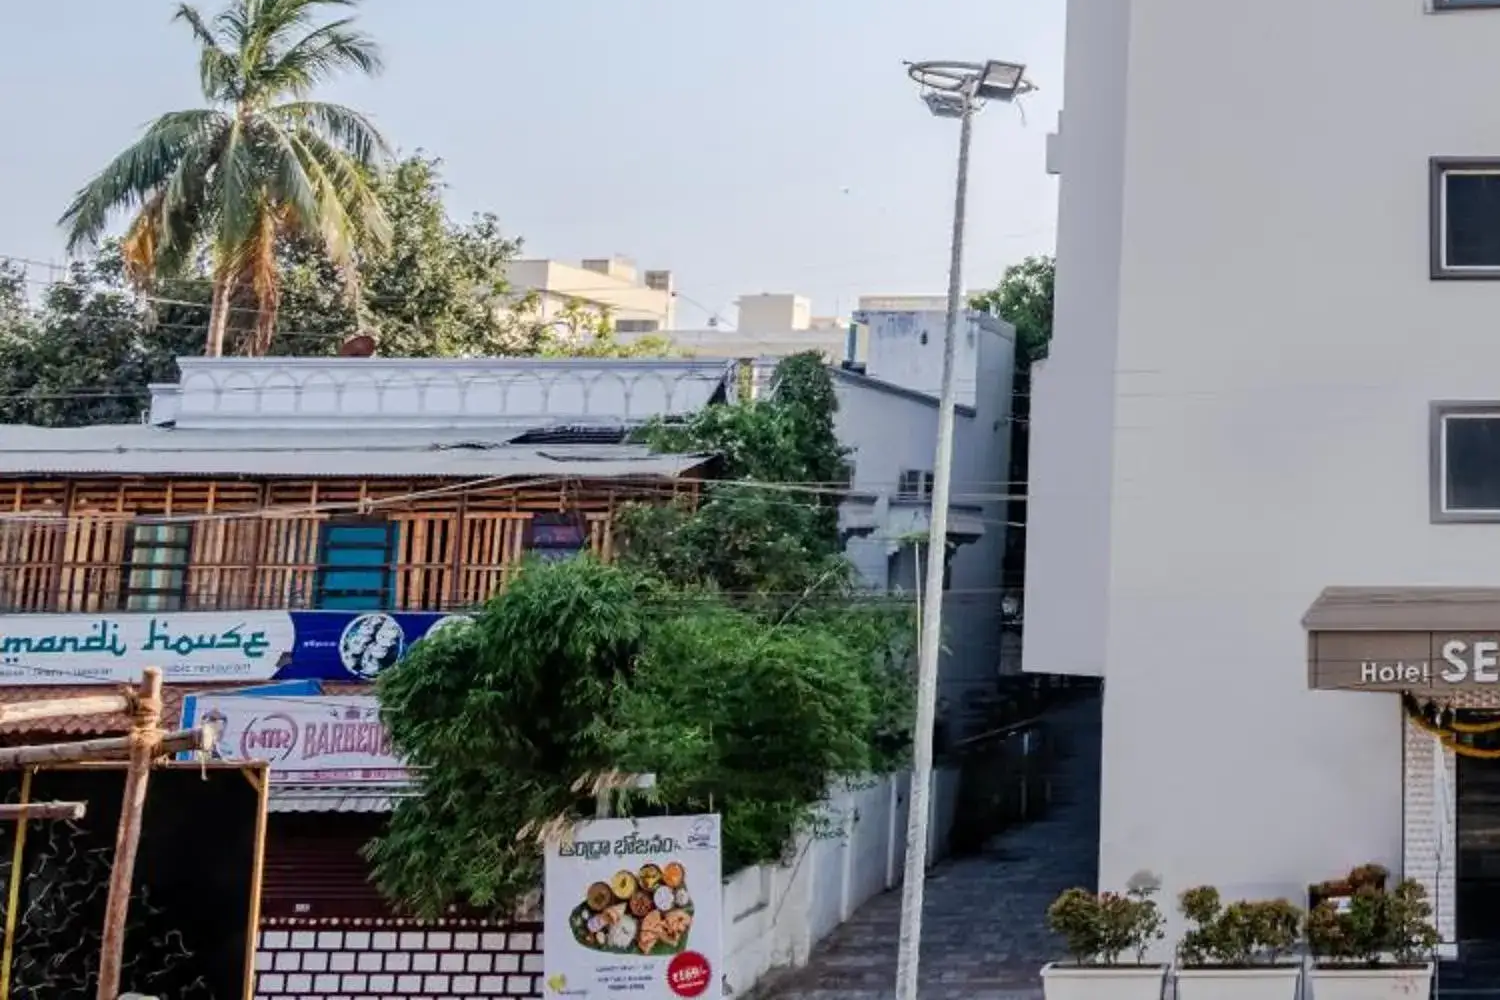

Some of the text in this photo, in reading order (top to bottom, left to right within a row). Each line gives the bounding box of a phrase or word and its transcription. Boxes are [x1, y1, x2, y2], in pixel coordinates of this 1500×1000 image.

[0, 618, 271, 662] mandi house
[1361, 661, 1428, 683] Hotel
